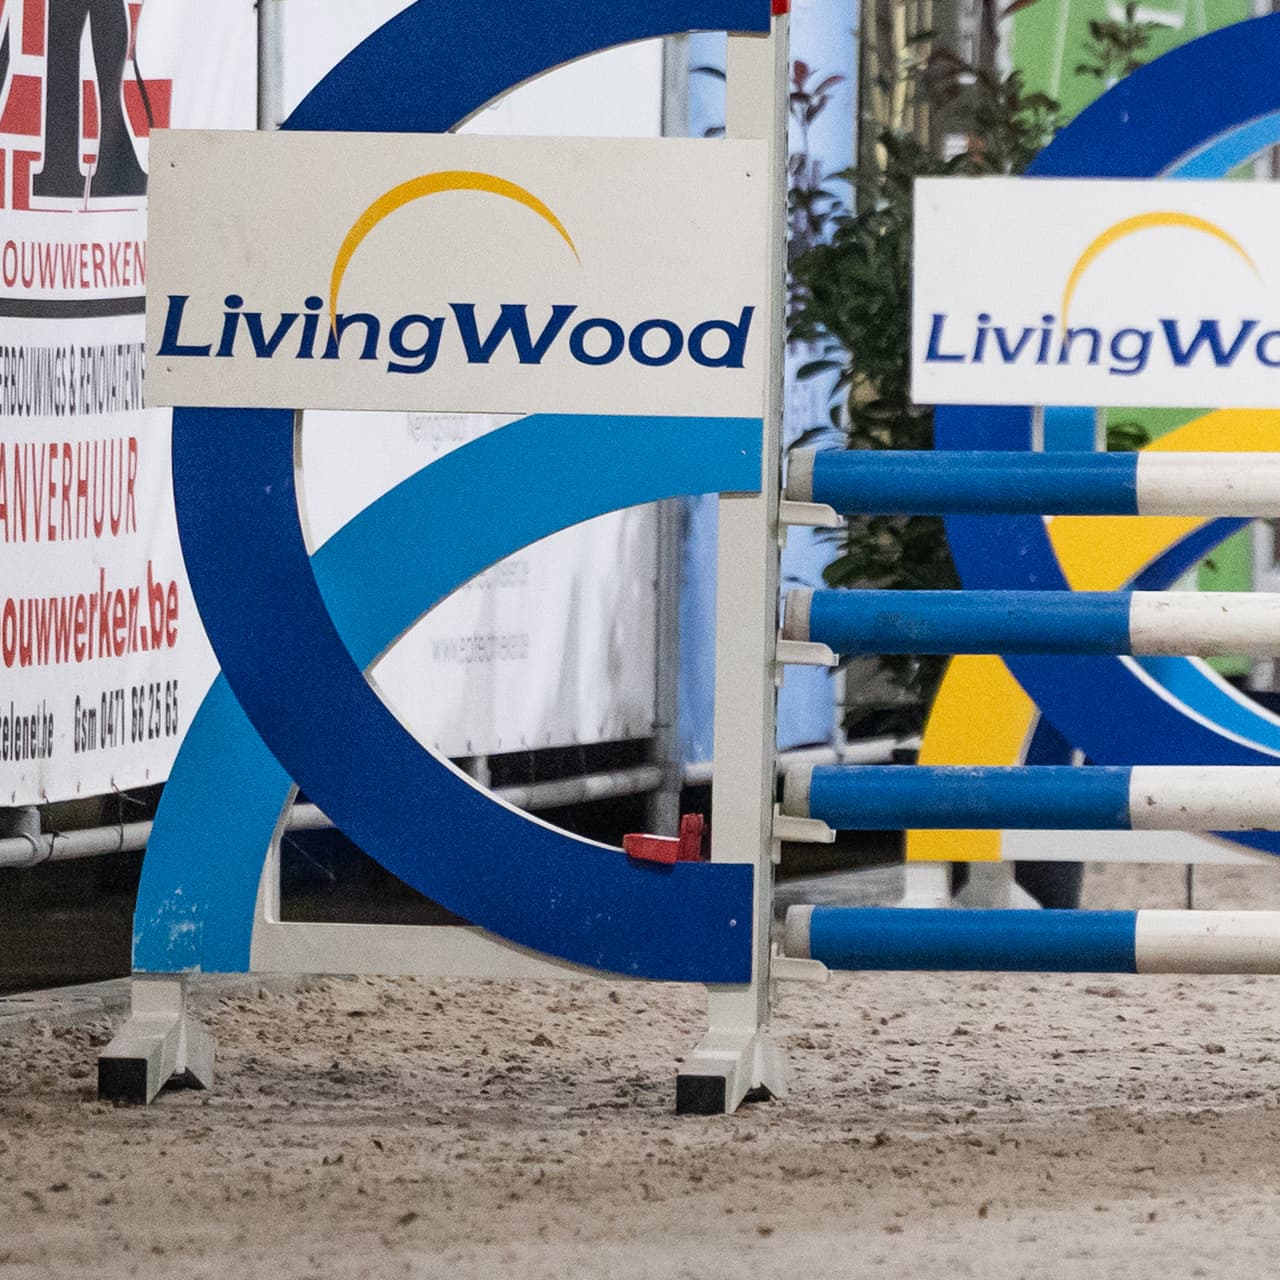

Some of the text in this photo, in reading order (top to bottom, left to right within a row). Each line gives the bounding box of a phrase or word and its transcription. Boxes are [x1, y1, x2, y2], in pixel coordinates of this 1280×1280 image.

[2, 239, 147, 289] OUWWERKEN
[156, 294, 756, 374] LivingWood
[2, 559, 178, 669] ouwwerken.be
[0, 698, 54, 761] elenet.be
[74, 694, 97, 754] Gsm
[100, 688, 125, 750] 0471
[148, 681, 161, 740] 25
[165, 679, 178, 737] 65
